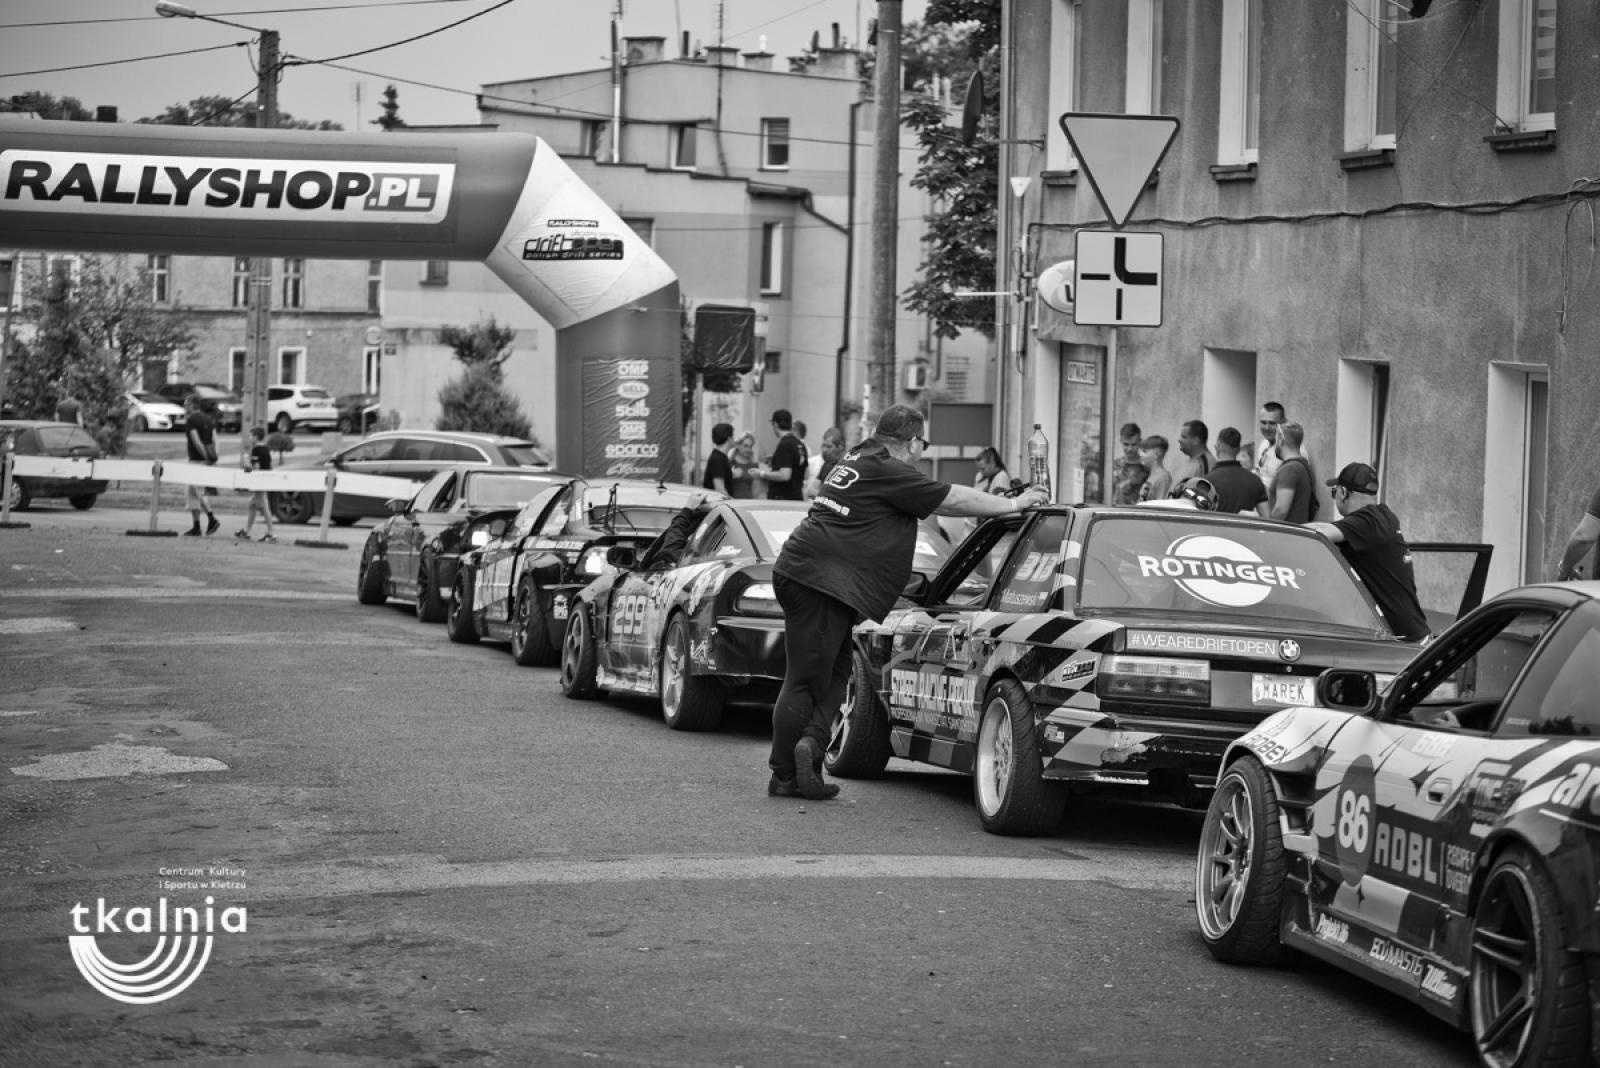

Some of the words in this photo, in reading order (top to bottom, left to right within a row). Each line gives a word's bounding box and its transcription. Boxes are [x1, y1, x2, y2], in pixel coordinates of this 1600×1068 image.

[5, 160, 432, 210] RALLYSHOP.PL
[618, 364, 649, 376] OMP
[1131, 632, 1276, 656] #WEAREDRIFTOPEN
[1338, 789, 1371, 853] 86
[1374, 822, 1437, 884] ADBL
